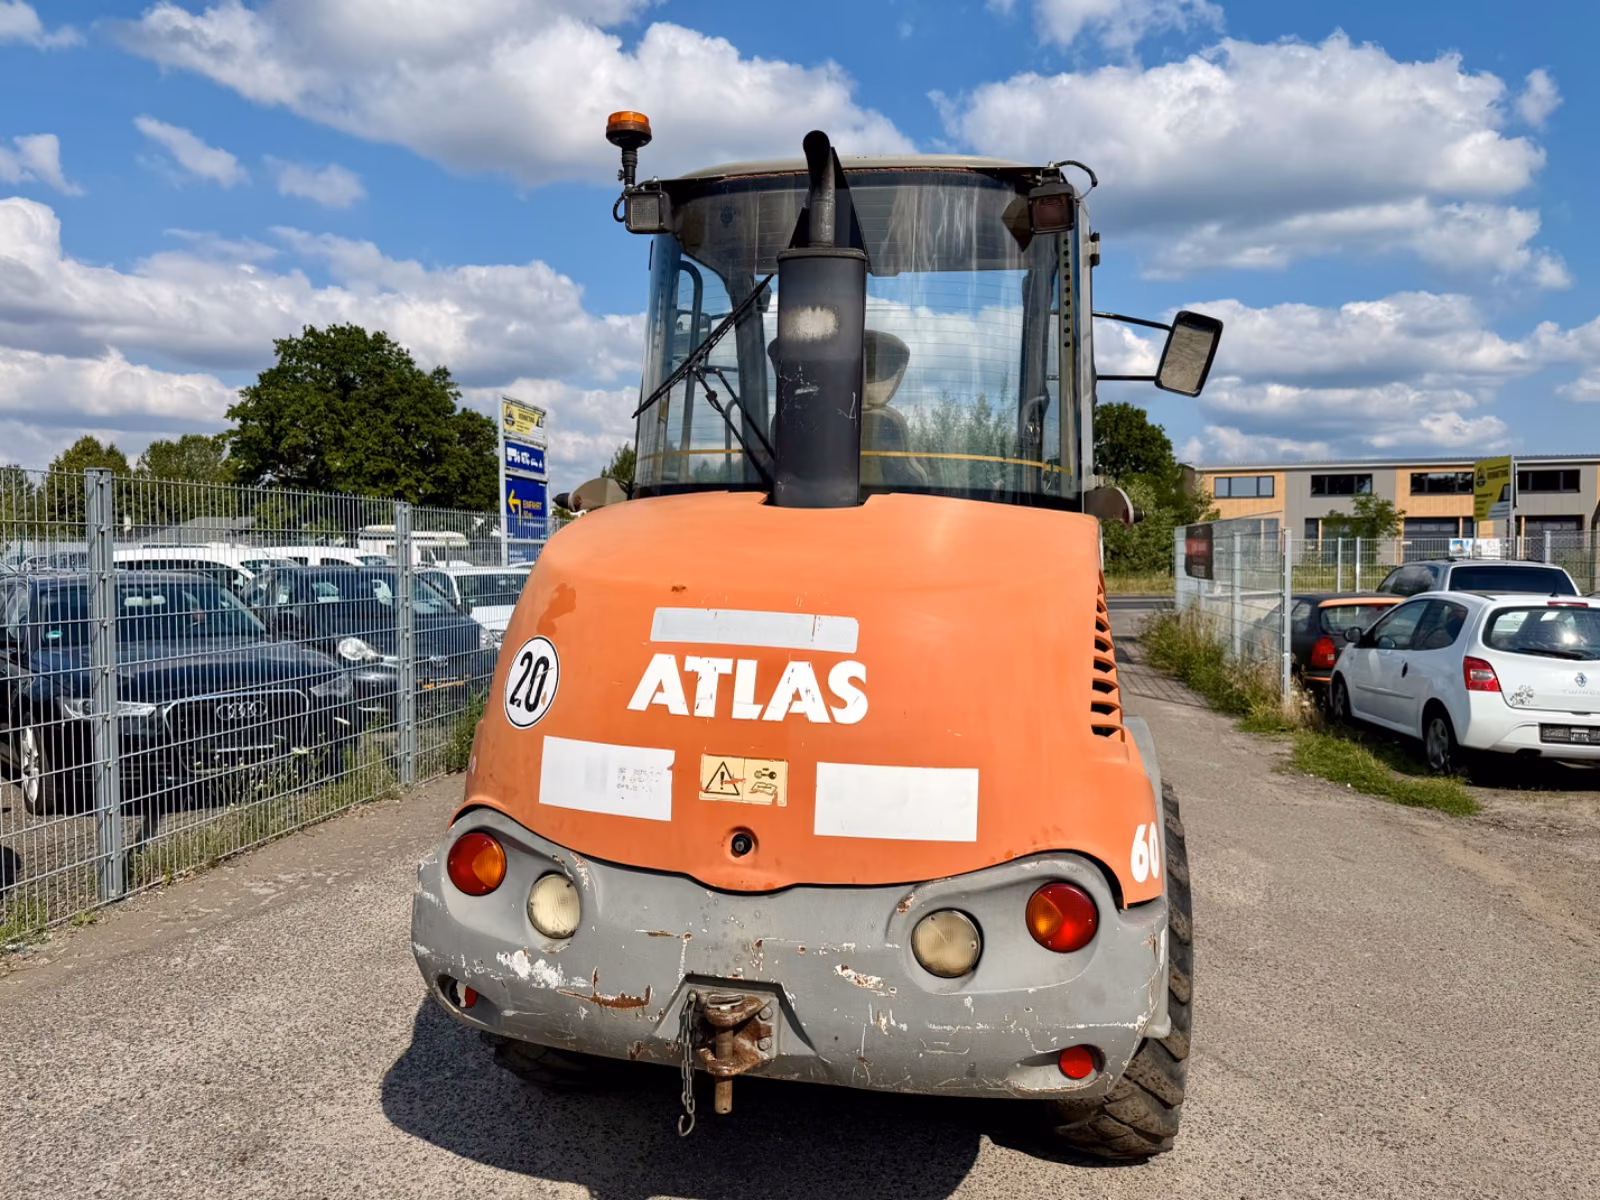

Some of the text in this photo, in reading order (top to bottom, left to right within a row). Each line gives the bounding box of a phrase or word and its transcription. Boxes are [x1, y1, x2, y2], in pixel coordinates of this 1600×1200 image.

[509, 651, 549, 712] 20
[627, 654, 868, 724] ATLAS
[1131, 822, 1160, 883] 60
